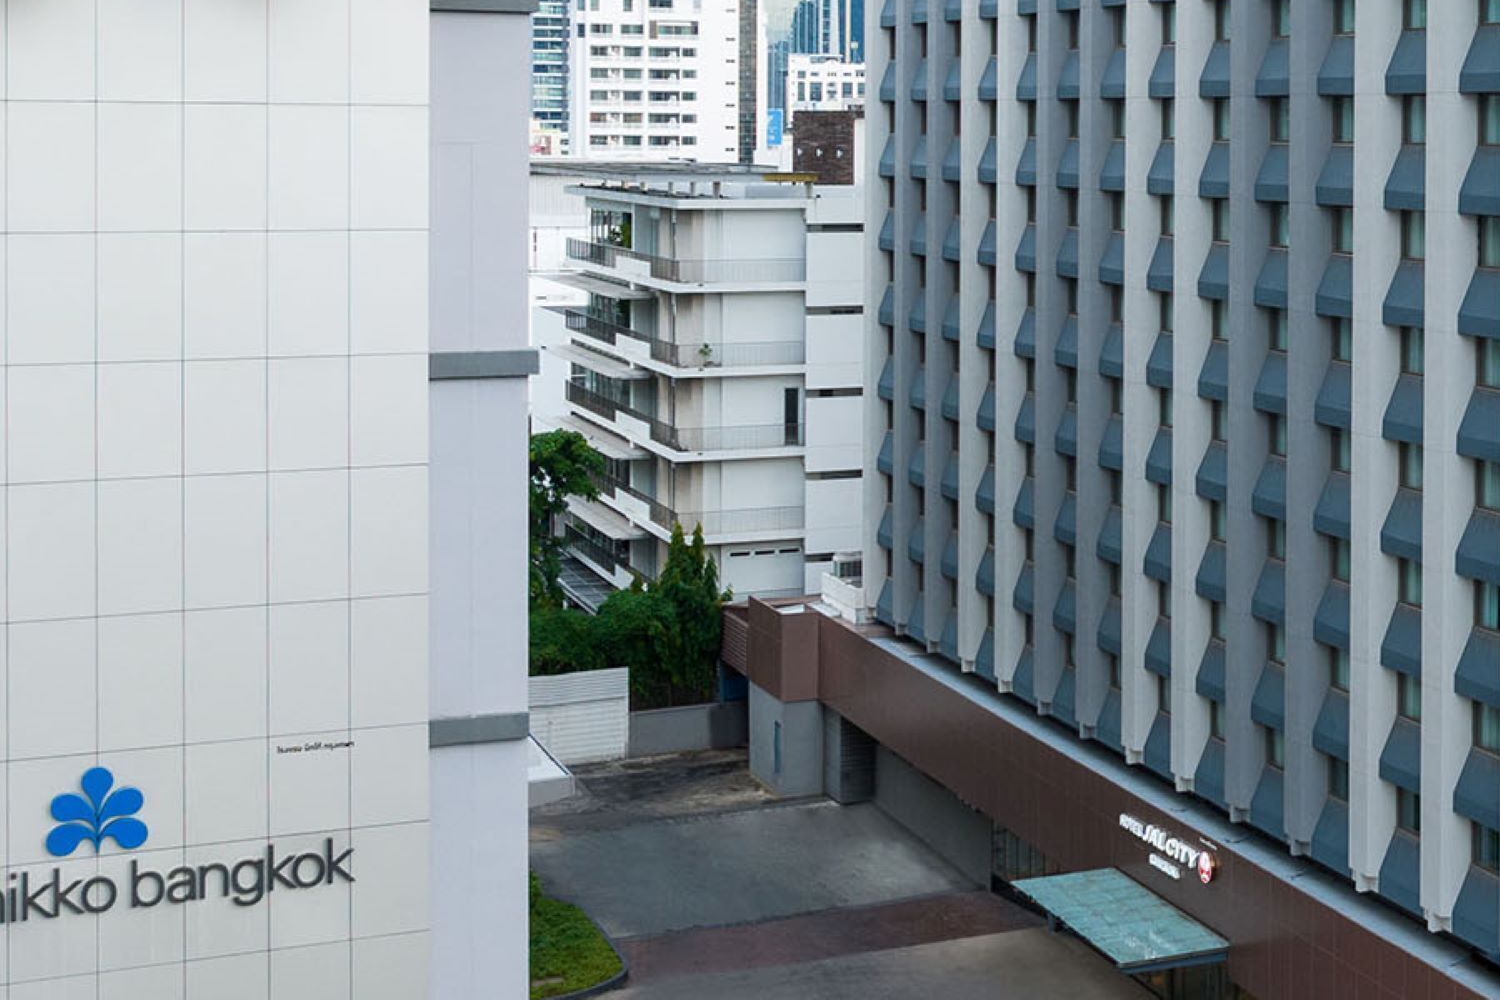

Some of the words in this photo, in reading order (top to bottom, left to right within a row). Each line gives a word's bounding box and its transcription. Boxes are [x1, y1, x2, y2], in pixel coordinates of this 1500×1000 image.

[0, 867, 117, 924] ikko
[130, 837, 356, 907] bangkok
[1165, 838, 1200, 868] CITY
